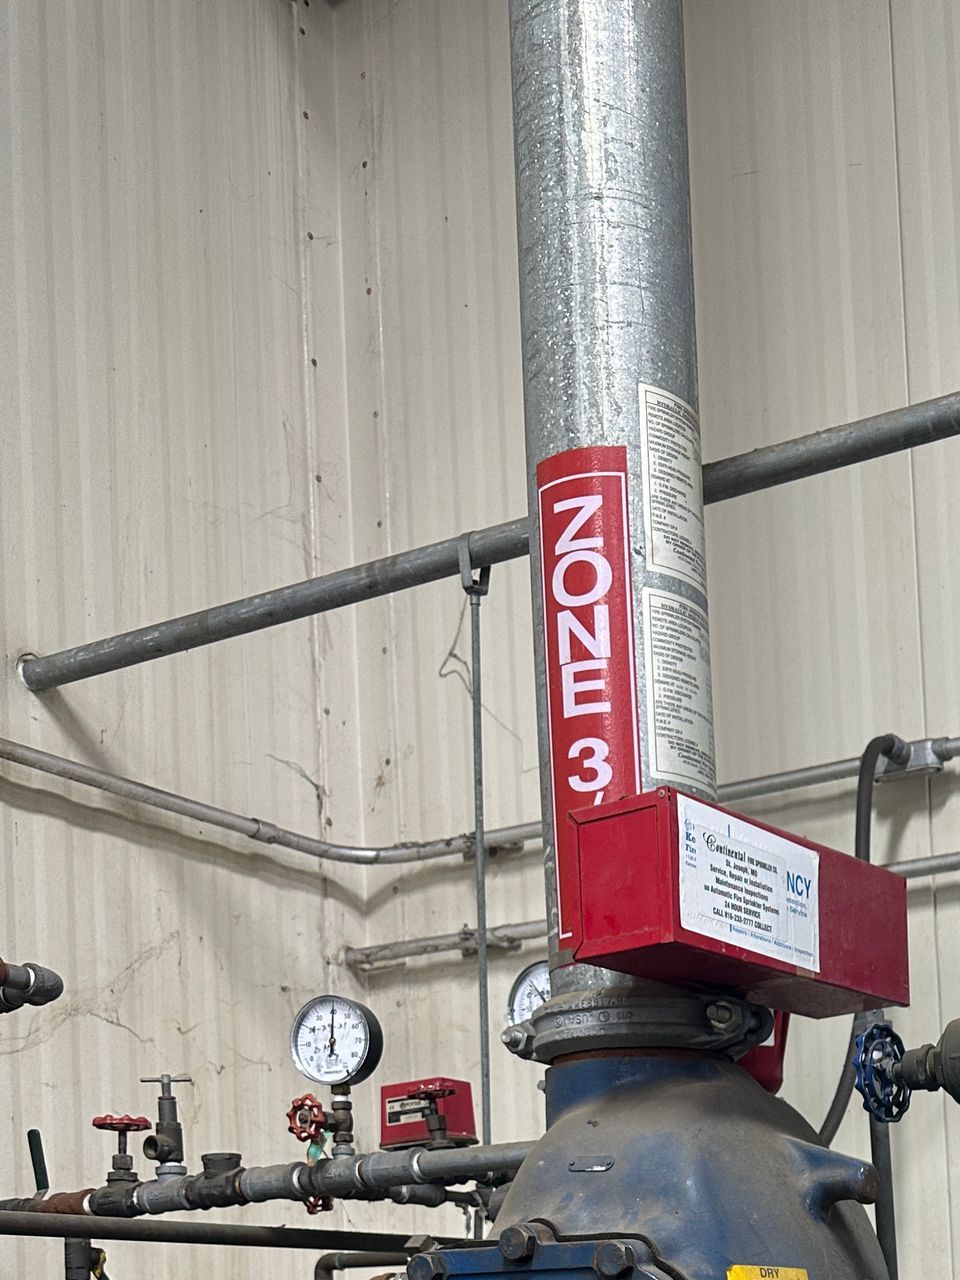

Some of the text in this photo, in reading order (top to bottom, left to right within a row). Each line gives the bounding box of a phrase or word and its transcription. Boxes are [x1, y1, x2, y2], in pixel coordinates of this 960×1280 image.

[552, 495, 613, 718] ZONE
[702, 832, 746, 862] Continental
[755, 858, 773, 873] SPRINKLER
[710, 864, 728, 878] Service,
[729, 870, 743, 883] Repair
[733, 861, 749, 875] Joseph,
[751, 866, 757, 877] MO
[711, 884, 732, 899] Automatic
[734, 893, 742, 902] Fire
[743, 895, 762, 909] Sprinkler
[716, 876, 768, 902] Maintenance Inspections
[713, 907, 723, 918] CALL
[754, 921, 772, 933] COLLECT
[724, 901, 761, 919] 24 HOUR SERVICE
[760, 1267, 780, 1279] DRY
